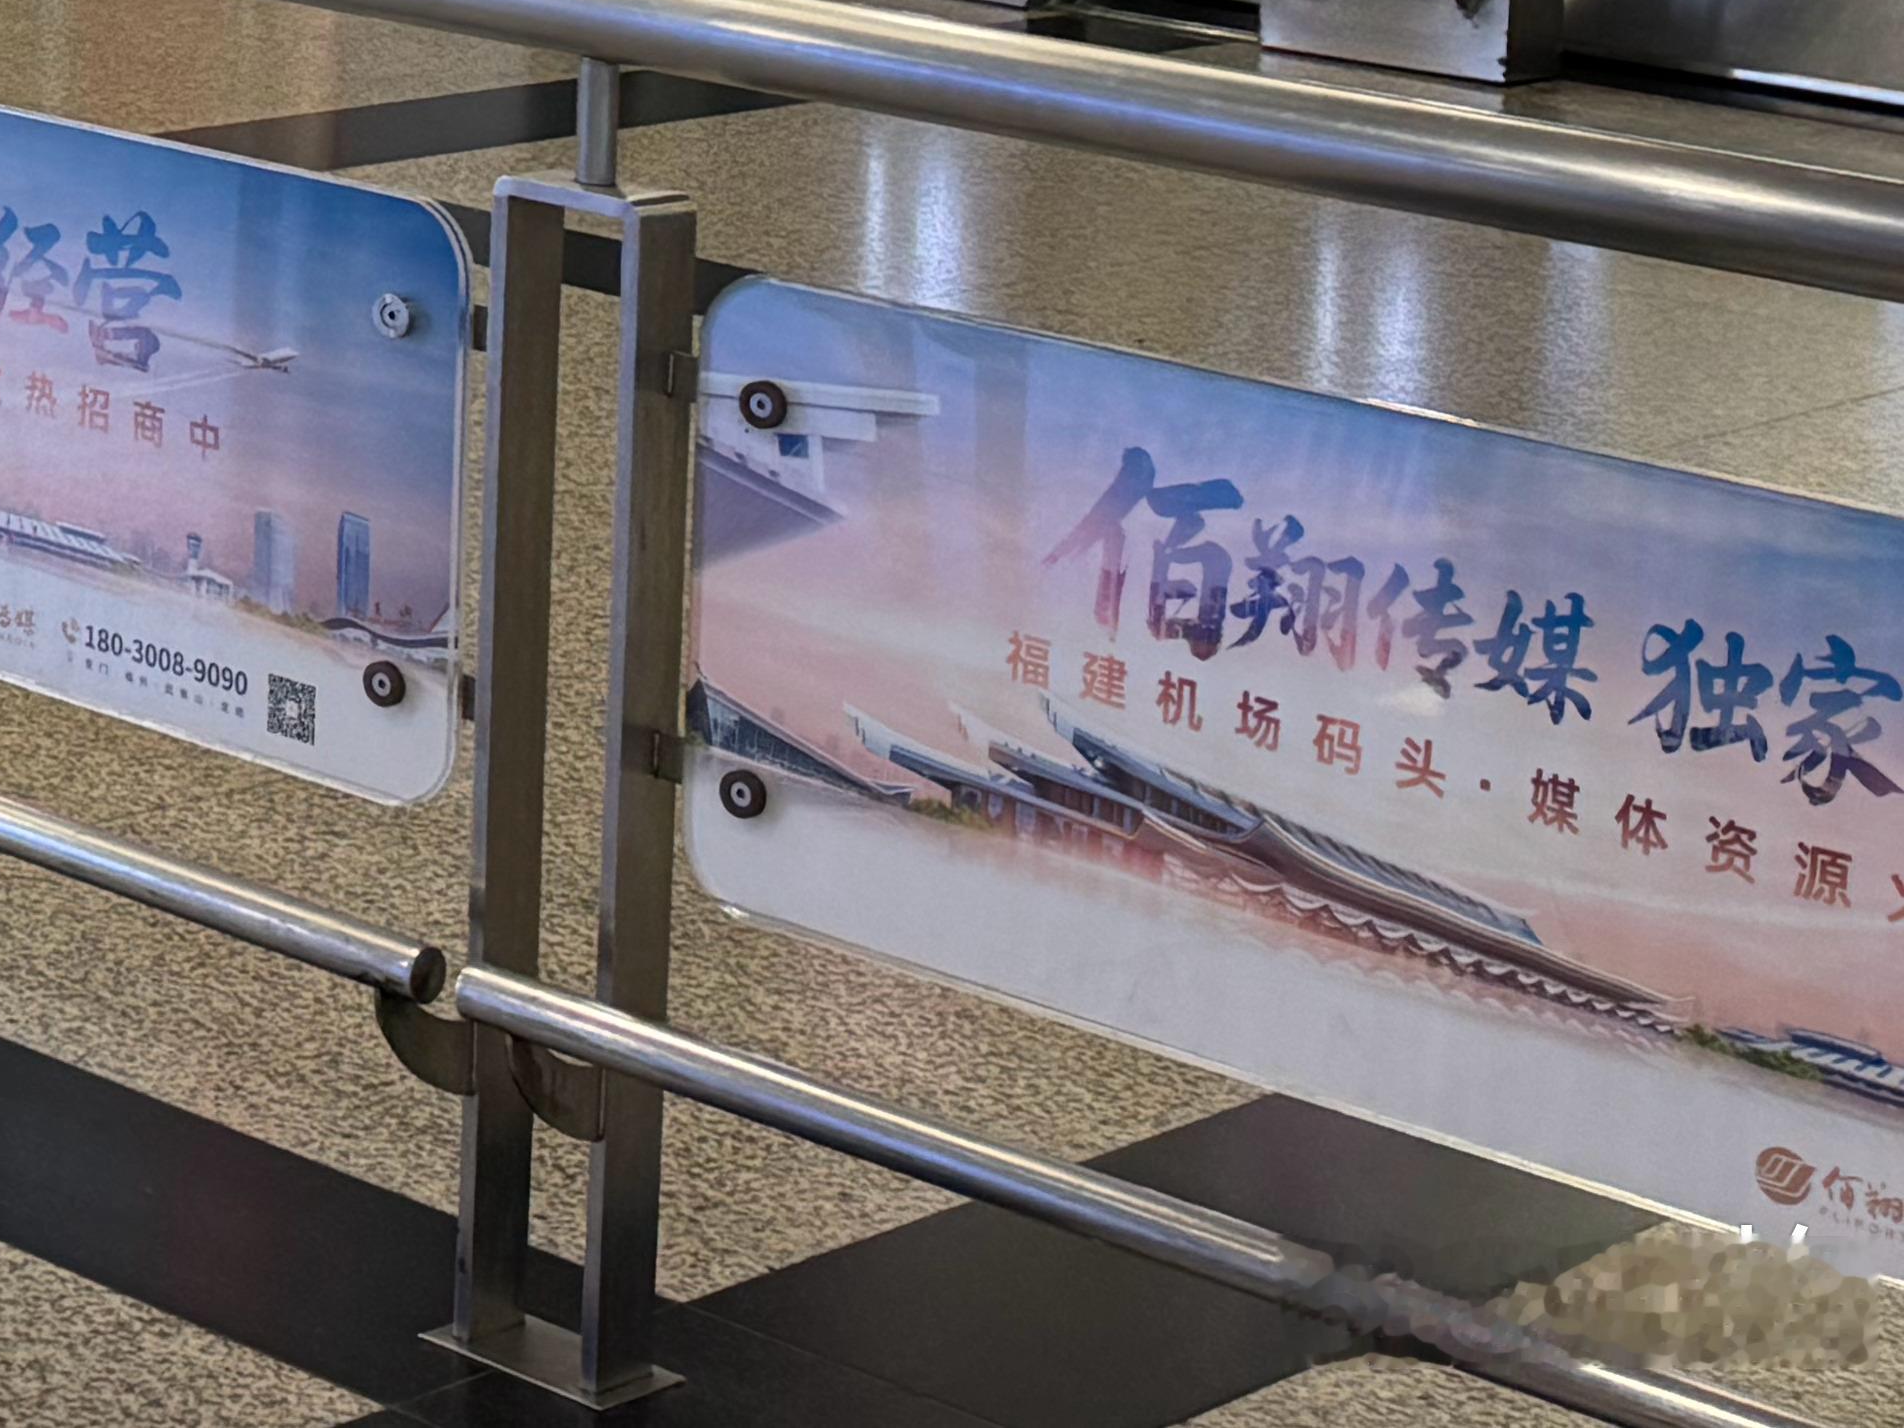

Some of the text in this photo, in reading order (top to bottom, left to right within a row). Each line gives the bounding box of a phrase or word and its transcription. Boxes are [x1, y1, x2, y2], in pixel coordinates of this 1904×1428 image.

[84, 624, 249, 697] 180-3008-9090
[1042, 446, 1904, 805] 佰翔传媒 独家
